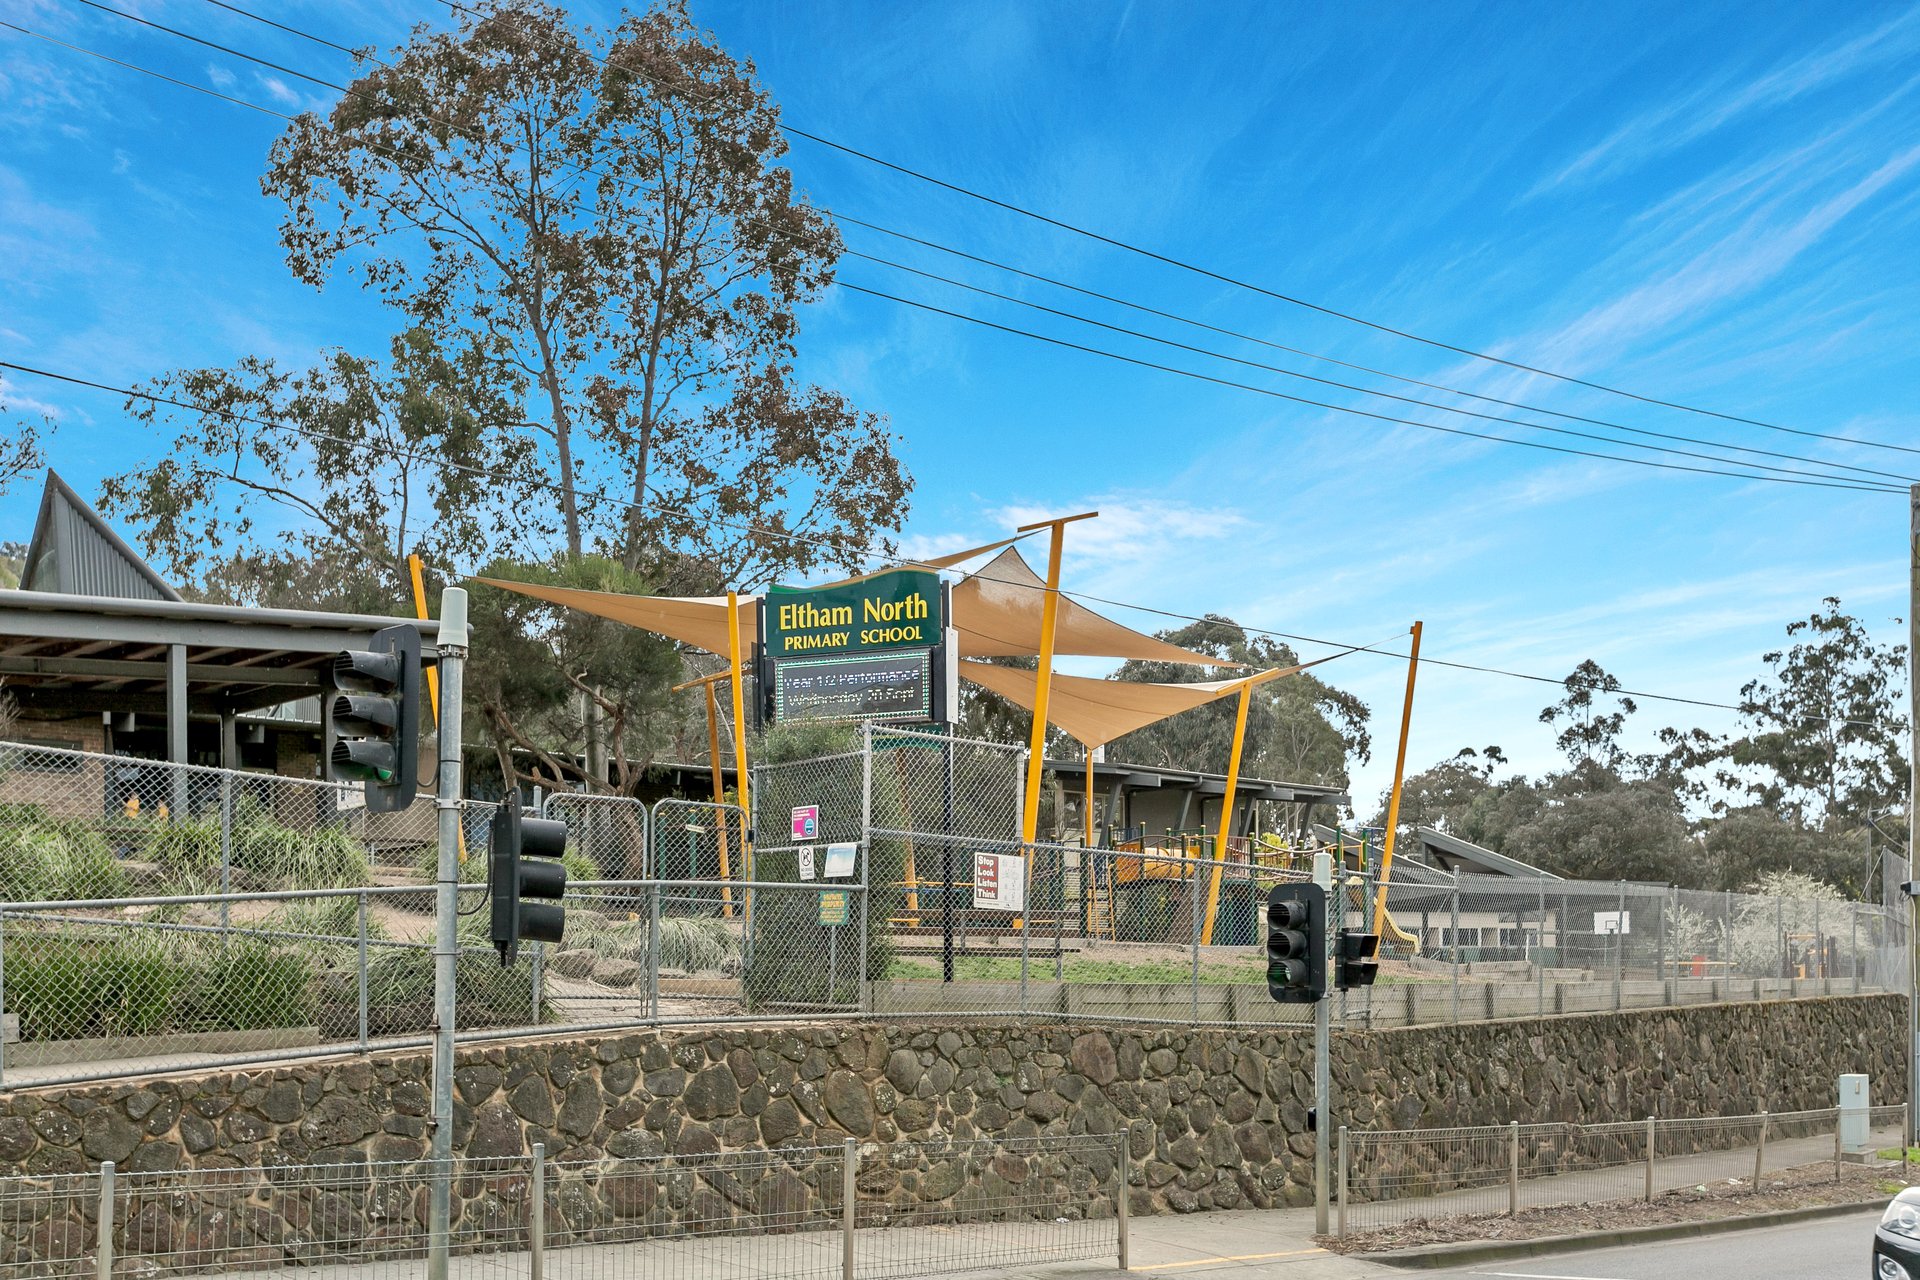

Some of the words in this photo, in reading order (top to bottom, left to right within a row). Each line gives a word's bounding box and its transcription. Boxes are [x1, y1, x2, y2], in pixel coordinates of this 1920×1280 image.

[779, 602, 853, 630] Eltham
[863, 592, 928, 623] North
[784, 632, 849, 651] PRIMARY
[860, 625, 923, 644] SCHOOL
[978, 856, 994, 867] Stop
[978, 866, 994, 877] Look
[978, 878, 997, 888] Listen
[978, 888, 996, 898] Think
